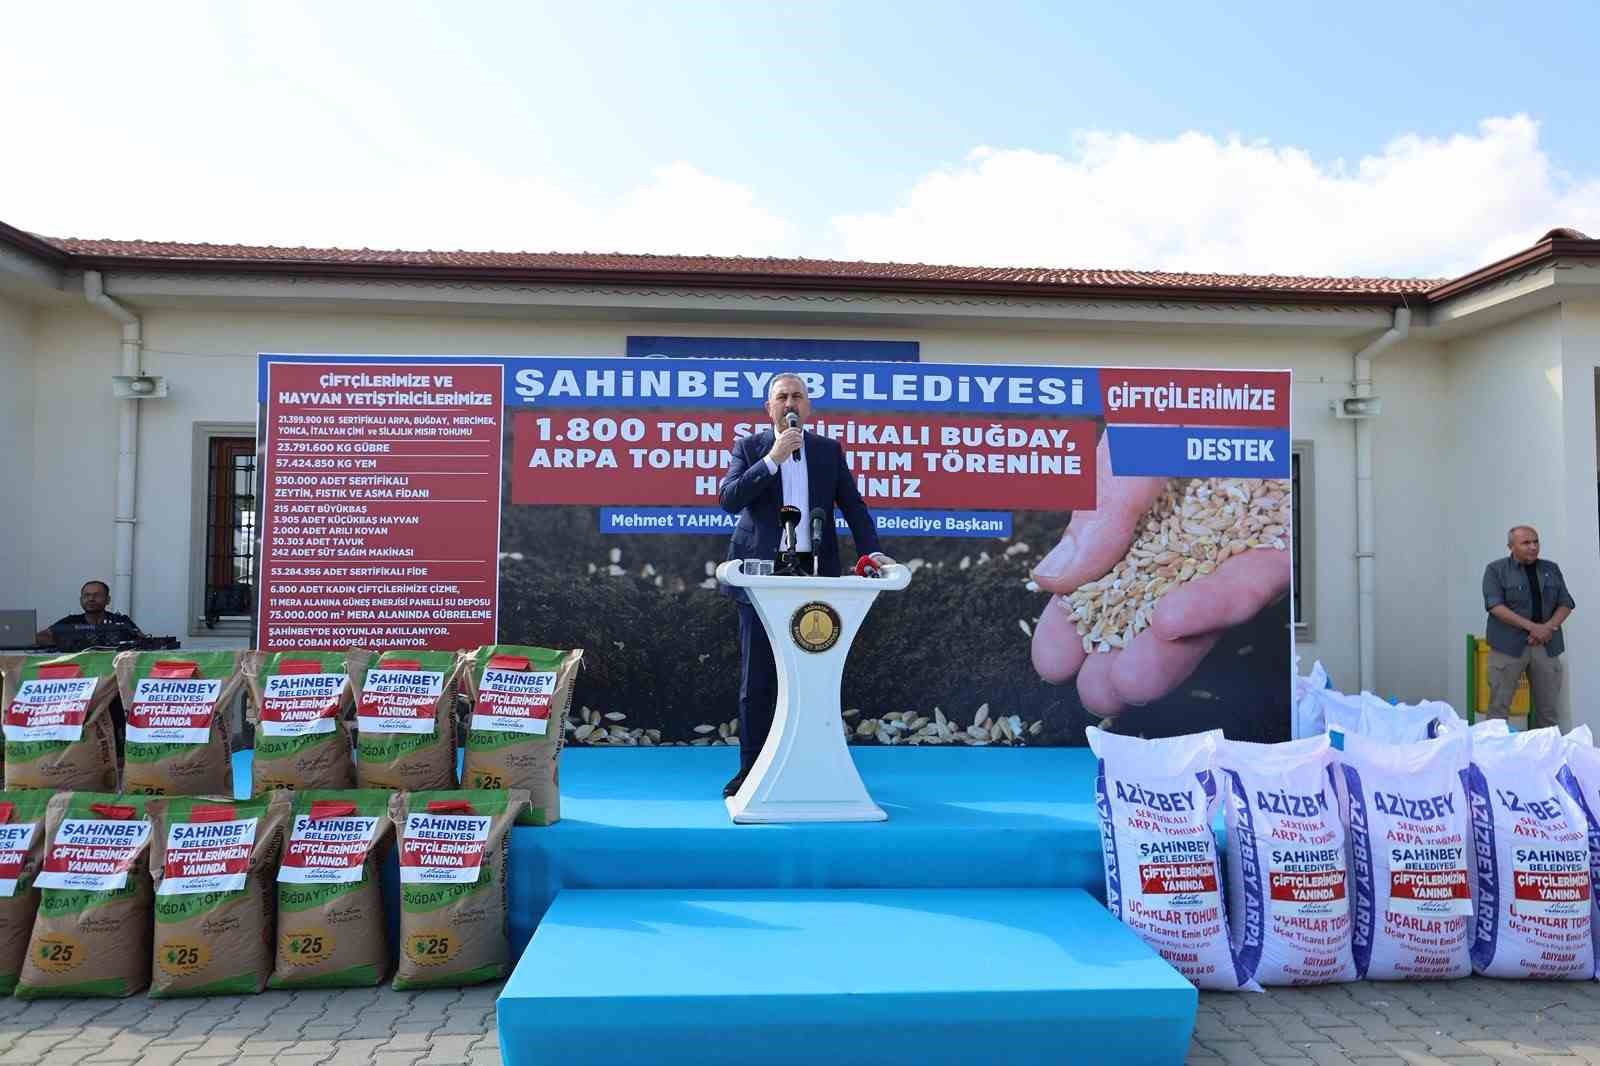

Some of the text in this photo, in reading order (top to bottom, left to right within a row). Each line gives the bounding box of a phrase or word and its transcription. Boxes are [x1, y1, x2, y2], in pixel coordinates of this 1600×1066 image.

[320, 373, 453, 389] ÇİFTÇİLERİMİZE VE
[280, 392, 492, 407] HAYVAN YETİŞTİRİCİLERİMİZE
[1108, 382, 1275, 412] ÇİFTÇİLERİMİZE
[324, 416, 334, 424] KG
[339, 415, 386, 424] SERTİFİKALI
[388, 417, 412, 426] ARPA,
[414, 416, 449, 426] BUĞDAY,
[453, 416, 496, 426] MERCİMEK,
[278, 427, 309, 436] YONCA,
[311, 426, 345, 435] İTALYAN
[414, 428, 436, 436] MISIR
[438, 428, 472, 436] TOHUMU
[536, 418, 645, 441] 1.800
[658, 422, 722, 441] TON
[941, 424, 1076, 452] BUĞDAY,
[277, 442, 390, 452] 23.791.600 KG GÜBRE
[1187, 438, 1274, 462] DESTEK
[276, 459, 376, 468] 57.424.850 KG YEM
[529, 449, 1080, 474] ARPA TOHU ITIM TÖRENİNE
[275, 476, 408, 486] 930.000 ADET SERTİFİKALI
[274, 488, 429, 499] ZEYTİN, FISTIK VE ASMA FİDANI
[274, 504, 367, 514] 215 ADET BÜYÜKBAŞ
[274, 515, 419, 525] 3.905 ADET KÜÇÜKBAŞ HAYVAN
[612, 514, 673, 527] Mehmet
[877, 516, 941, 530] Belediye
[946, 517, 1002, 532] Başkanı
[273, 527, 388, 535] 2.000 ADET ARILI KOVAN
[272, 538, 364, 546] 30.303 ADET TAVUK
[318, 548, 336, 556] SÜT
[337, 548, 366, 556] SAĞIM
[369, 547, 414, 556] MAKİNASI
[323, 568, 348, 576] ADET
[350, 567, 404, 576] SERTİFİKALI
[407, 567, 428, 576] FİDE
[271, 585, 297, 593] 6.800
[357, 584, 427, 595] ÇİFTÇİLERİMİZE
[430, 584, 460, 595] ÇİZME,
[343, 598, 371, 608] GÜNEŞ
[372, 598, 407, 606] ENERJİSİ
[410, 598, 444, 606] PANELLİ
[270, 610, 328, 619] 75.000.000
[348, 611, 374, 619] MERA
[377, 611, 430, 619] ALANINDA
[433, 609, 492, 619] GÜBRELEME
[332, 628, 383, 636] KOYUNLAR
[386, 628, 450, 636] AKILLANIYOR.
[269, 637, 428, 648] 2.000 ÇOBAN KÖPEĞİ AŞILANIYOR.
[280, 711, 321, 721] YANINDA
[377, 706, 417, 717] YANINDA
[492, 705, 530, 716] YANINDA
[148, 717, 191, 726] YANINDA
[484, 776, 501, 790] 25
[304, 855, 348, 866] YANINDA
[420, 854, 463, 866] YANINDA
[68, 862, 114, 873] YANINDA
[183, 862, 226, 875] YANINDA
[1349, 793, 1371, 947] AZİZBEY ARPA
[1469, 792, 1494, 942] AZİZBEY ARPA
[1292, 888, 1334, 900] YANINDA
[1538, 888, 1581, 900] YANINDA
[301, 937, 322, 953] 25
[427, 938, 448, 954] 25
[50, 945, 72, 961] 25
[177, 948, 198, 965] 25
